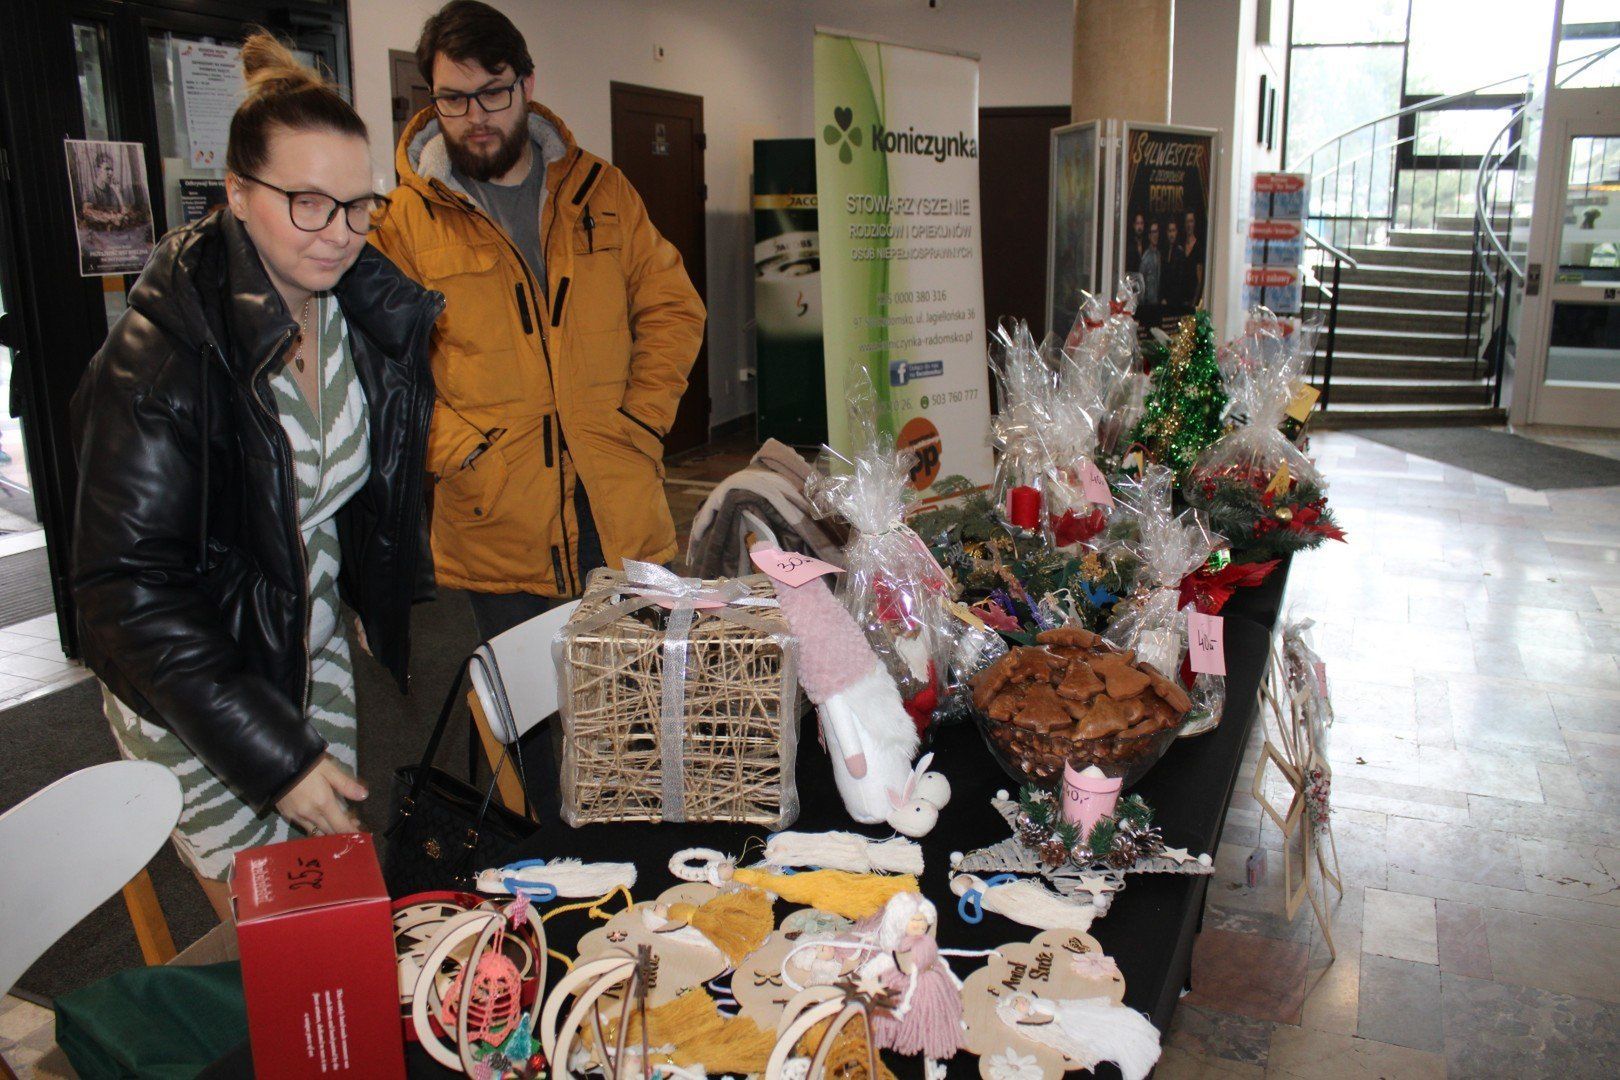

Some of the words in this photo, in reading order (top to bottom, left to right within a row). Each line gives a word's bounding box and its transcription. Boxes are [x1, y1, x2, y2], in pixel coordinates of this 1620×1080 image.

[872, 124, 977, 163] Koniczynka
[1133, 132, 1204, 166] SYLWESTER
[846, 195, 971, 216] STOWARZYSZENIE
[850, 223, 903, 239] RODZICÓW
[911, 223, 971, 239] OPIEKUNÓW
[851, 247, 875, 262] OSÓB
[877, 247, 973, 261] NIEPEŁNOSPRAWNYCH
[895, 292, 914, 303] 0000
[916, 291, 930, 302] 380
[933, 289, 947, 301] 316
[967, 308, 976, 320] 36
[932, 394, 946, 406] 503
[948, 392, 963, 403] 760
